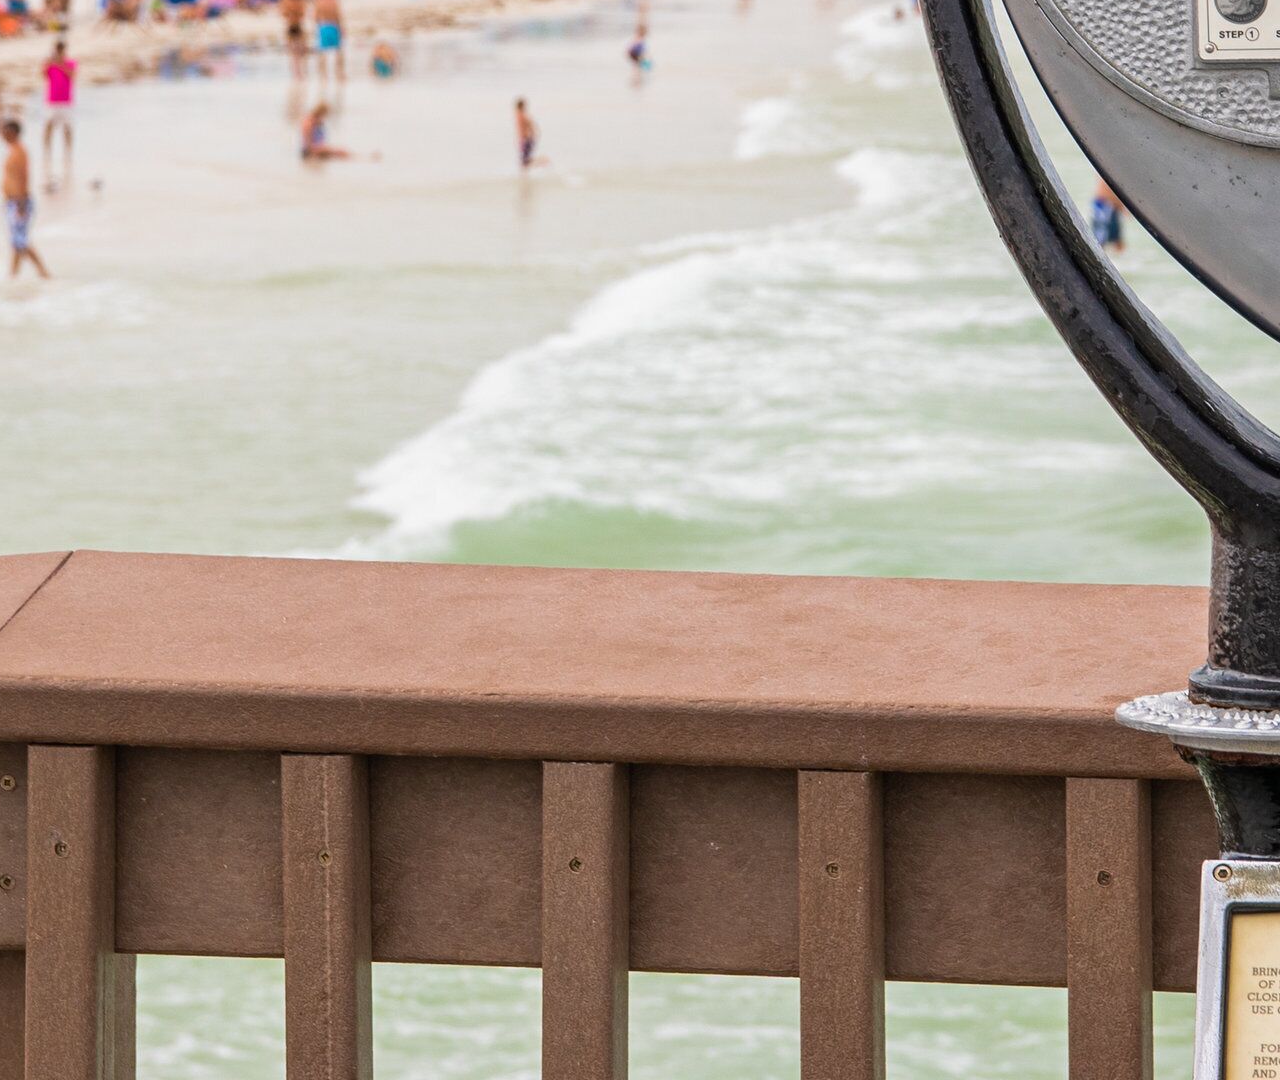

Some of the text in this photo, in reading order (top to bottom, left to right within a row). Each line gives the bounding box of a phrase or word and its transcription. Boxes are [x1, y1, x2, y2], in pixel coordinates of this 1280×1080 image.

[1219, 30, 1244, 39] STEP
[1258, 980, 1275, 989] OF
[1252, 1005, 1273, 1014] USE
[1252, 1069, 1276, 1079] AND
